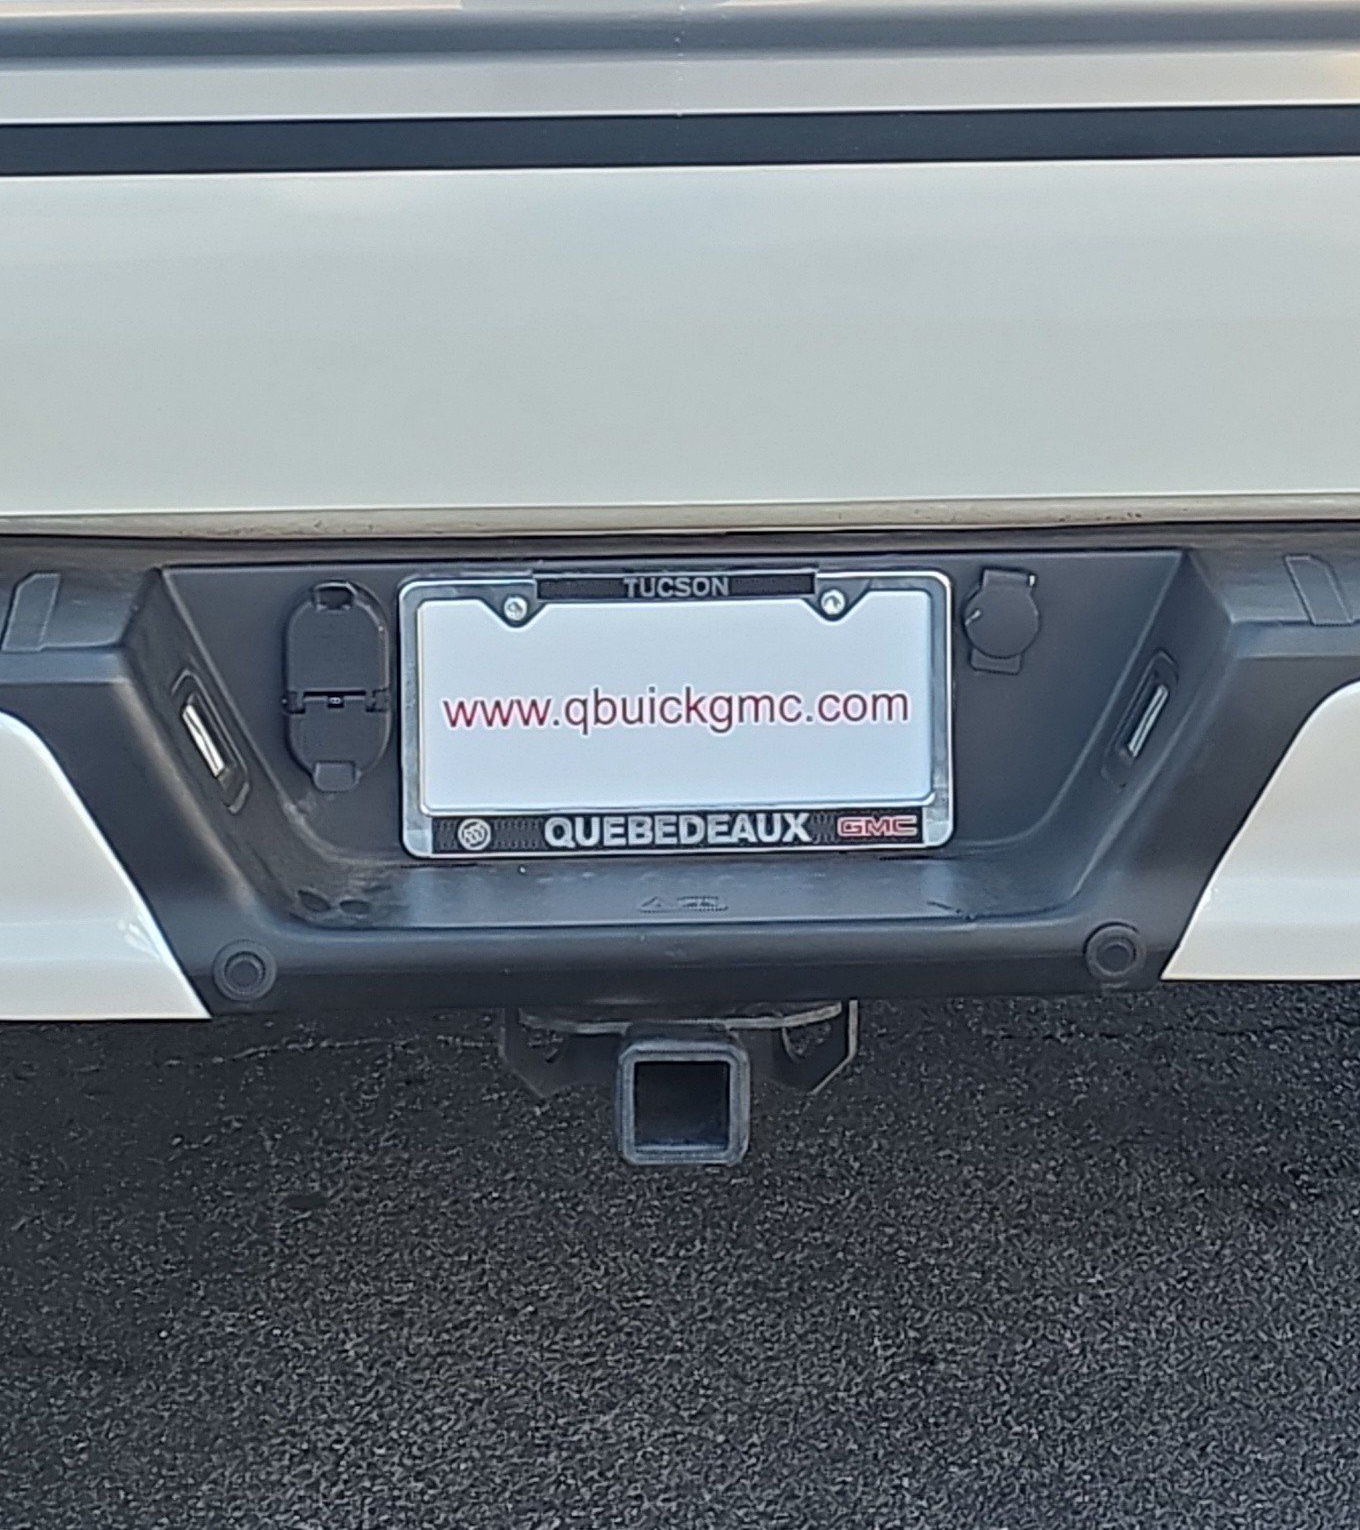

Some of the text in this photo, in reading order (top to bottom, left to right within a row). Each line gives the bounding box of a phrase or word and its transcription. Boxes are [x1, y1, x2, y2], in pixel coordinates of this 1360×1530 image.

[623, 576, 730, 598] TUCSON
[442, 686, 910, 733] www.qbuickgmc.com
[544, 811, 919, 849] QUEBEDEAUX GMC
